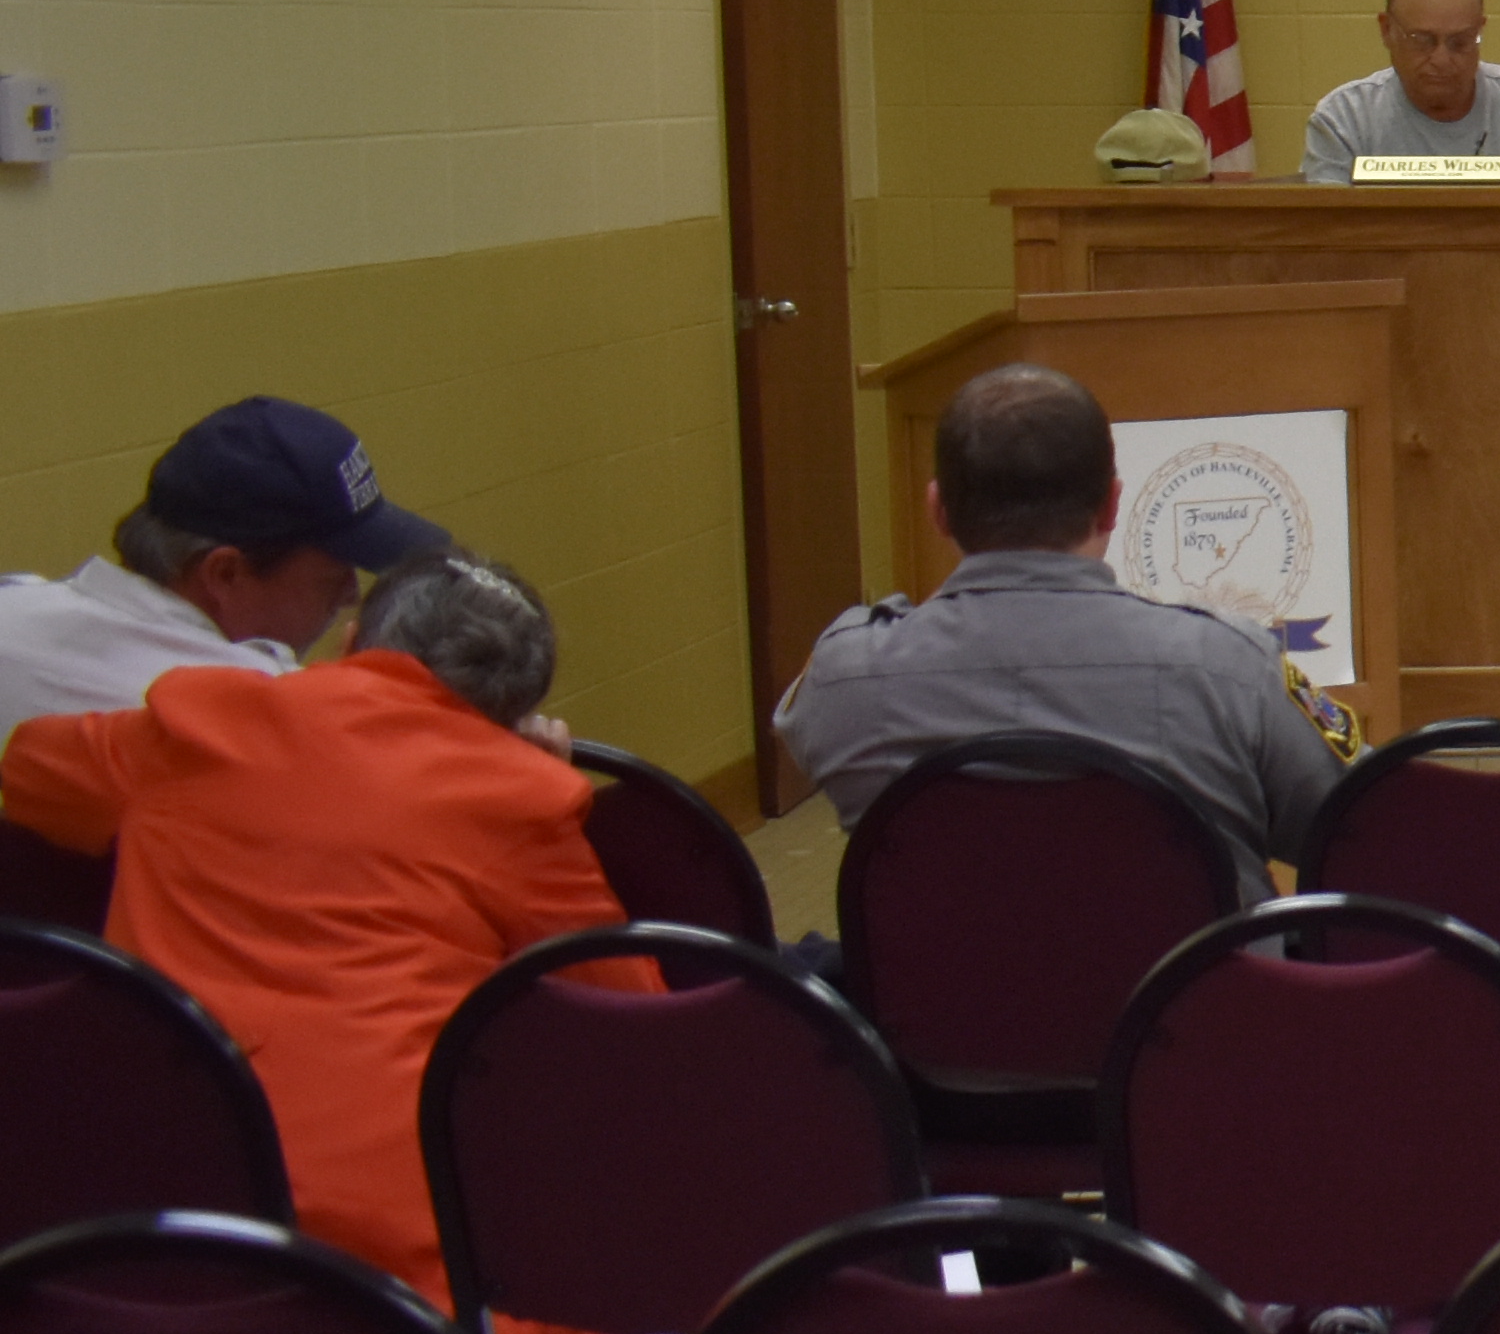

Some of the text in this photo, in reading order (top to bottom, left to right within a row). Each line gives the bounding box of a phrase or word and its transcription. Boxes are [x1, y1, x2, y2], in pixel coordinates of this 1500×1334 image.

[1362, 158, 1437, 172] CHARLES
[1190, 464, 1207, 477] OF
[1162, 474, 1188, 498] CITY
[1146, 502, 1164, 525] THE
[1184, 504, 1249, 527] Founded
[1143, 532, 1153, 549] OF
[1184, 531, 1216, 550] 1879
[1280, 508, 1295, 573] ALABAMA
[1143, 555, 1160, 586] SEAL
